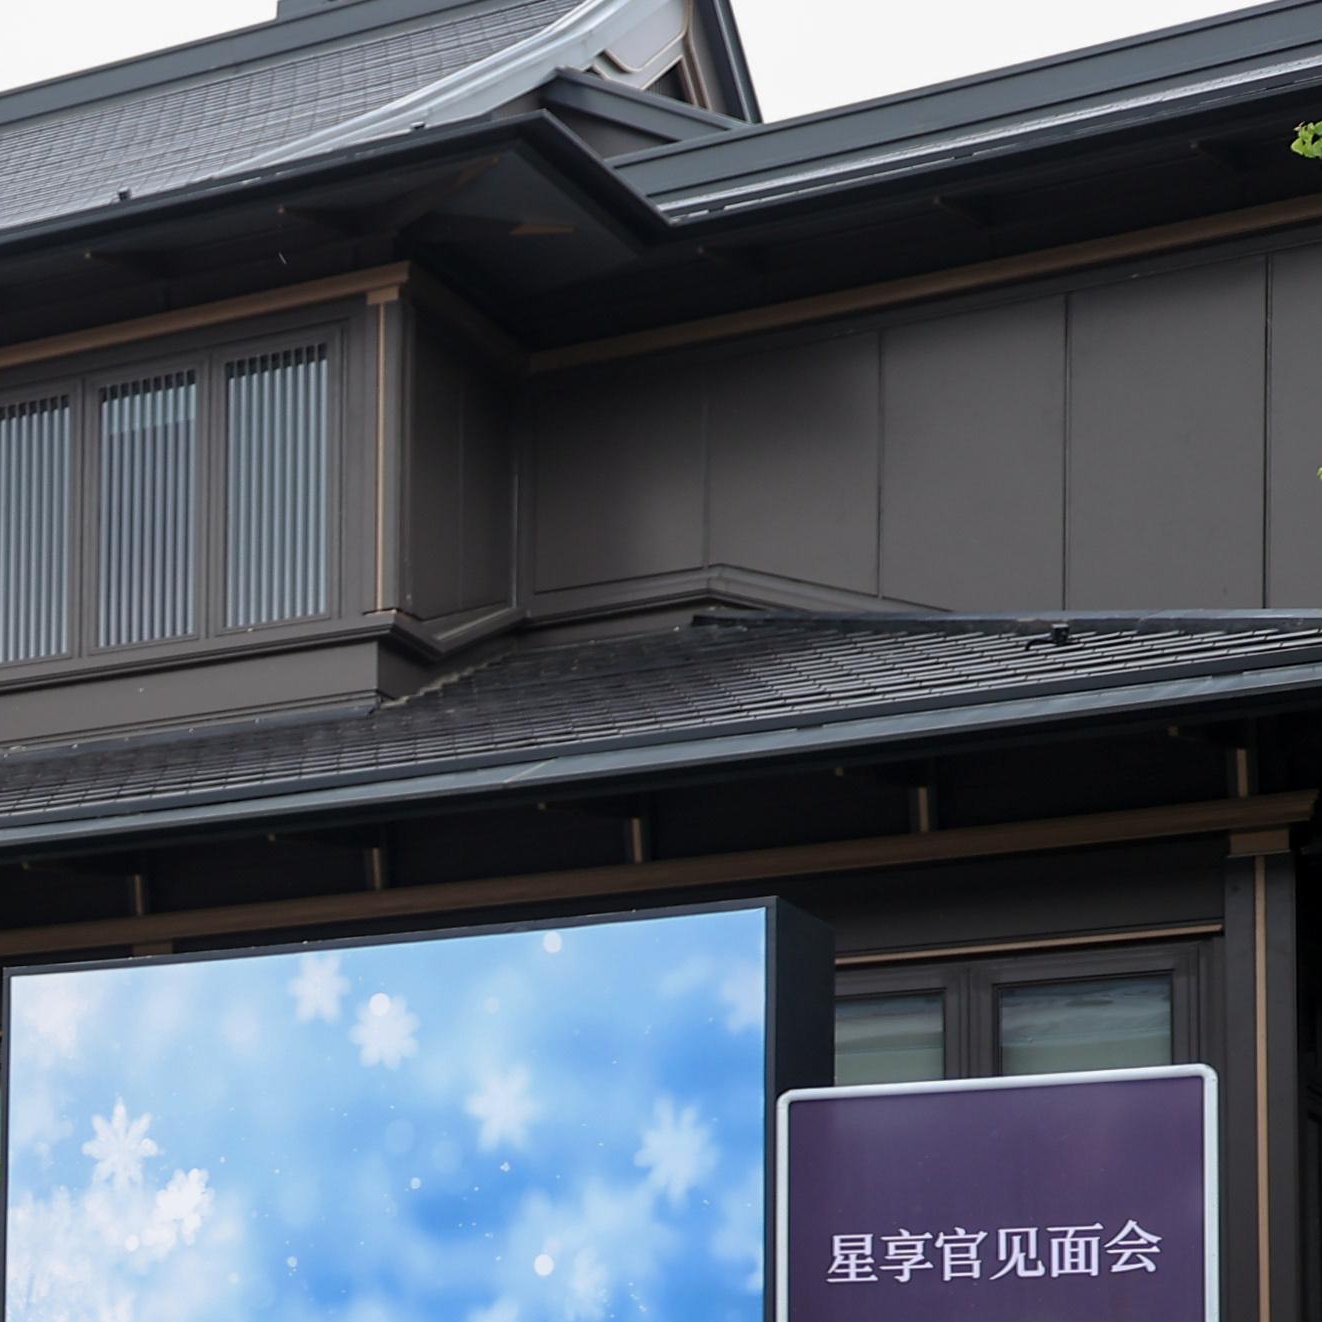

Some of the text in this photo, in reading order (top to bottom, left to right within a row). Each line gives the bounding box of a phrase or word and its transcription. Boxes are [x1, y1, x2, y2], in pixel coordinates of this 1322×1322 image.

[826, 1219, 1162, 1283] 星享官见面会
